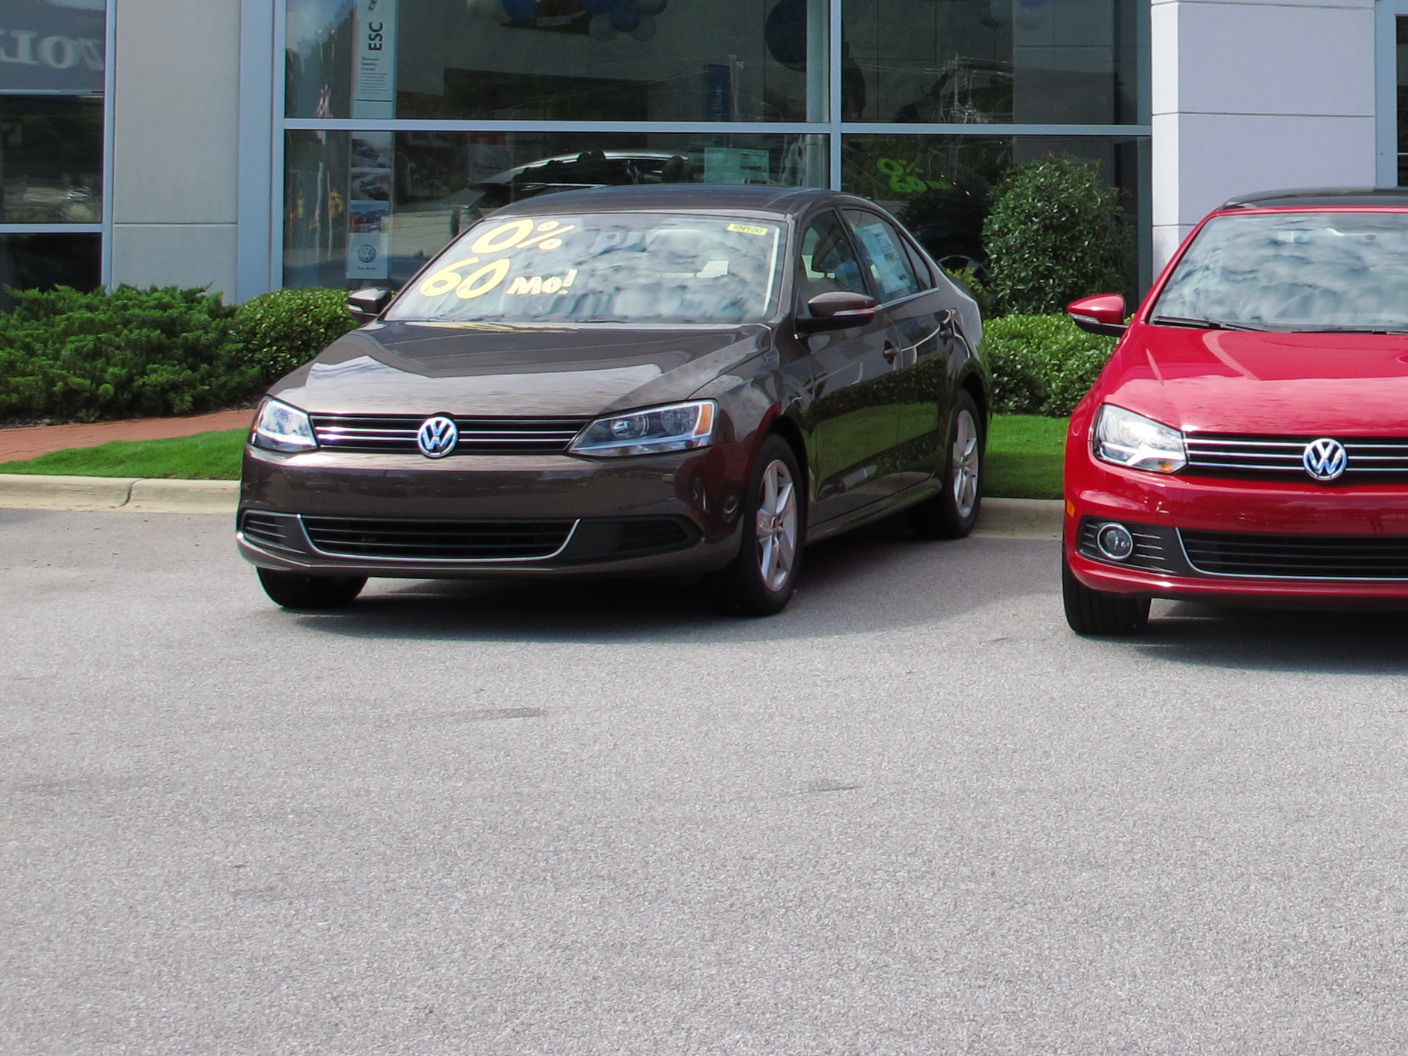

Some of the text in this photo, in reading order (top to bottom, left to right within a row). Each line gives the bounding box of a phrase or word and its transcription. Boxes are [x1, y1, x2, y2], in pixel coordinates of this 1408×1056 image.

[368, 21, 383, 51] ESC
[471, 218, 576, 254] 0%
[420, 256, 511, 300] 60
